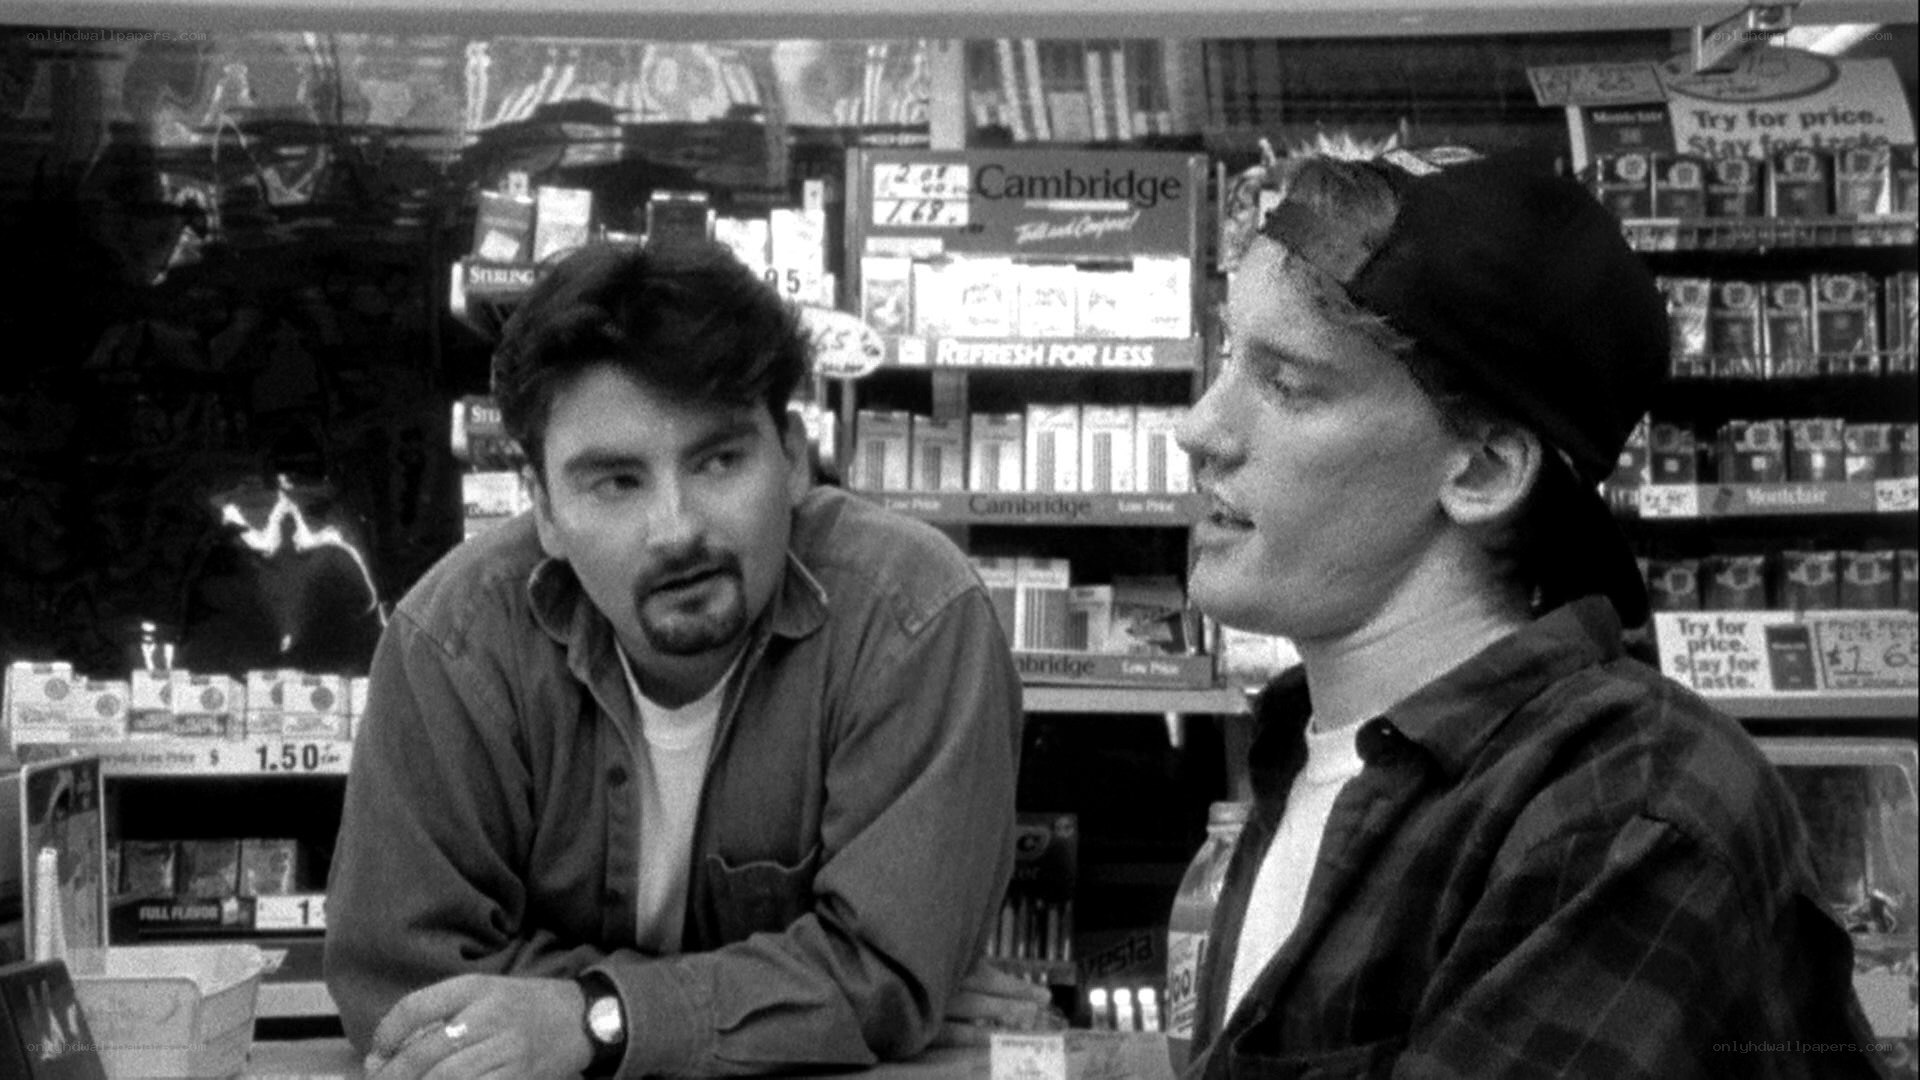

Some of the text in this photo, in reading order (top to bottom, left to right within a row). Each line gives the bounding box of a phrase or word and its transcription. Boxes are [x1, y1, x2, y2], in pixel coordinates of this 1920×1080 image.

[1692, 110, 1736, 132] Try
[1746, 108, 1787, 128] for
[975, 164, 1182, 207] Cambridge
[937, 339, 1154, 367] REFRESH FOR LESS
[968, 494, 1091, 518] Cambridge
[1678, 617, 1710, 638] Try
[256, 744, 319, 770] 1.50
[139, 905, 219, 921] FULL FLAVOR
